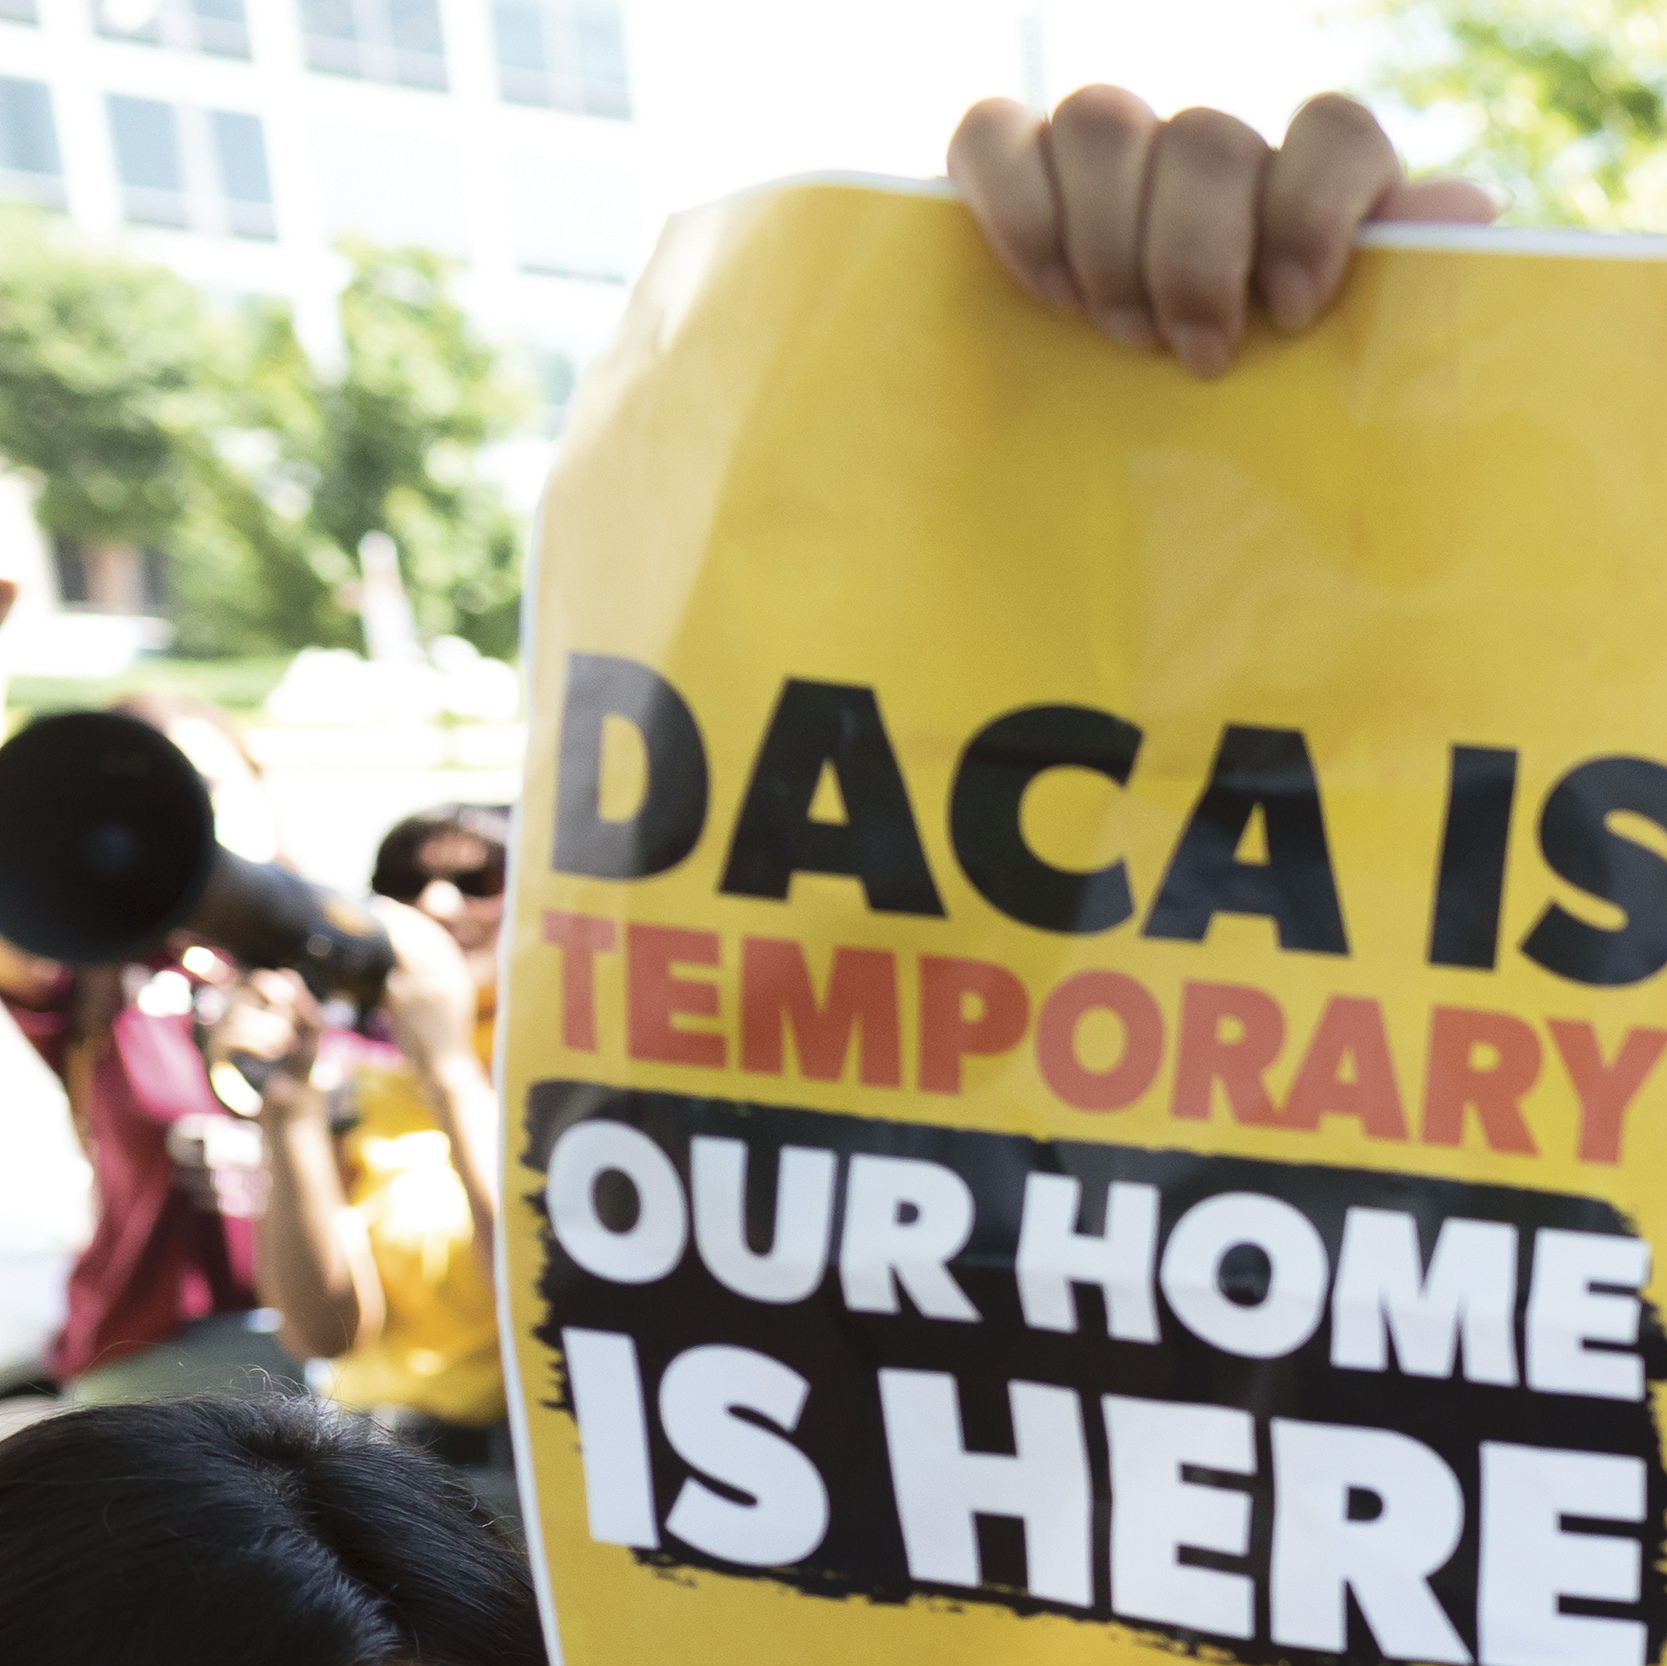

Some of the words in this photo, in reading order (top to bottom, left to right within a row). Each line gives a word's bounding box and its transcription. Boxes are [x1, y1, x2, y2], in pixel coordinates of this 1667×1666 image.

[547, 651, 1353, 958] DACA
[545, 1119, 984, 1322] OUR
[1014, 1170, 1651, 1400] HOME
[561, 1325, 831, 1568] IS
